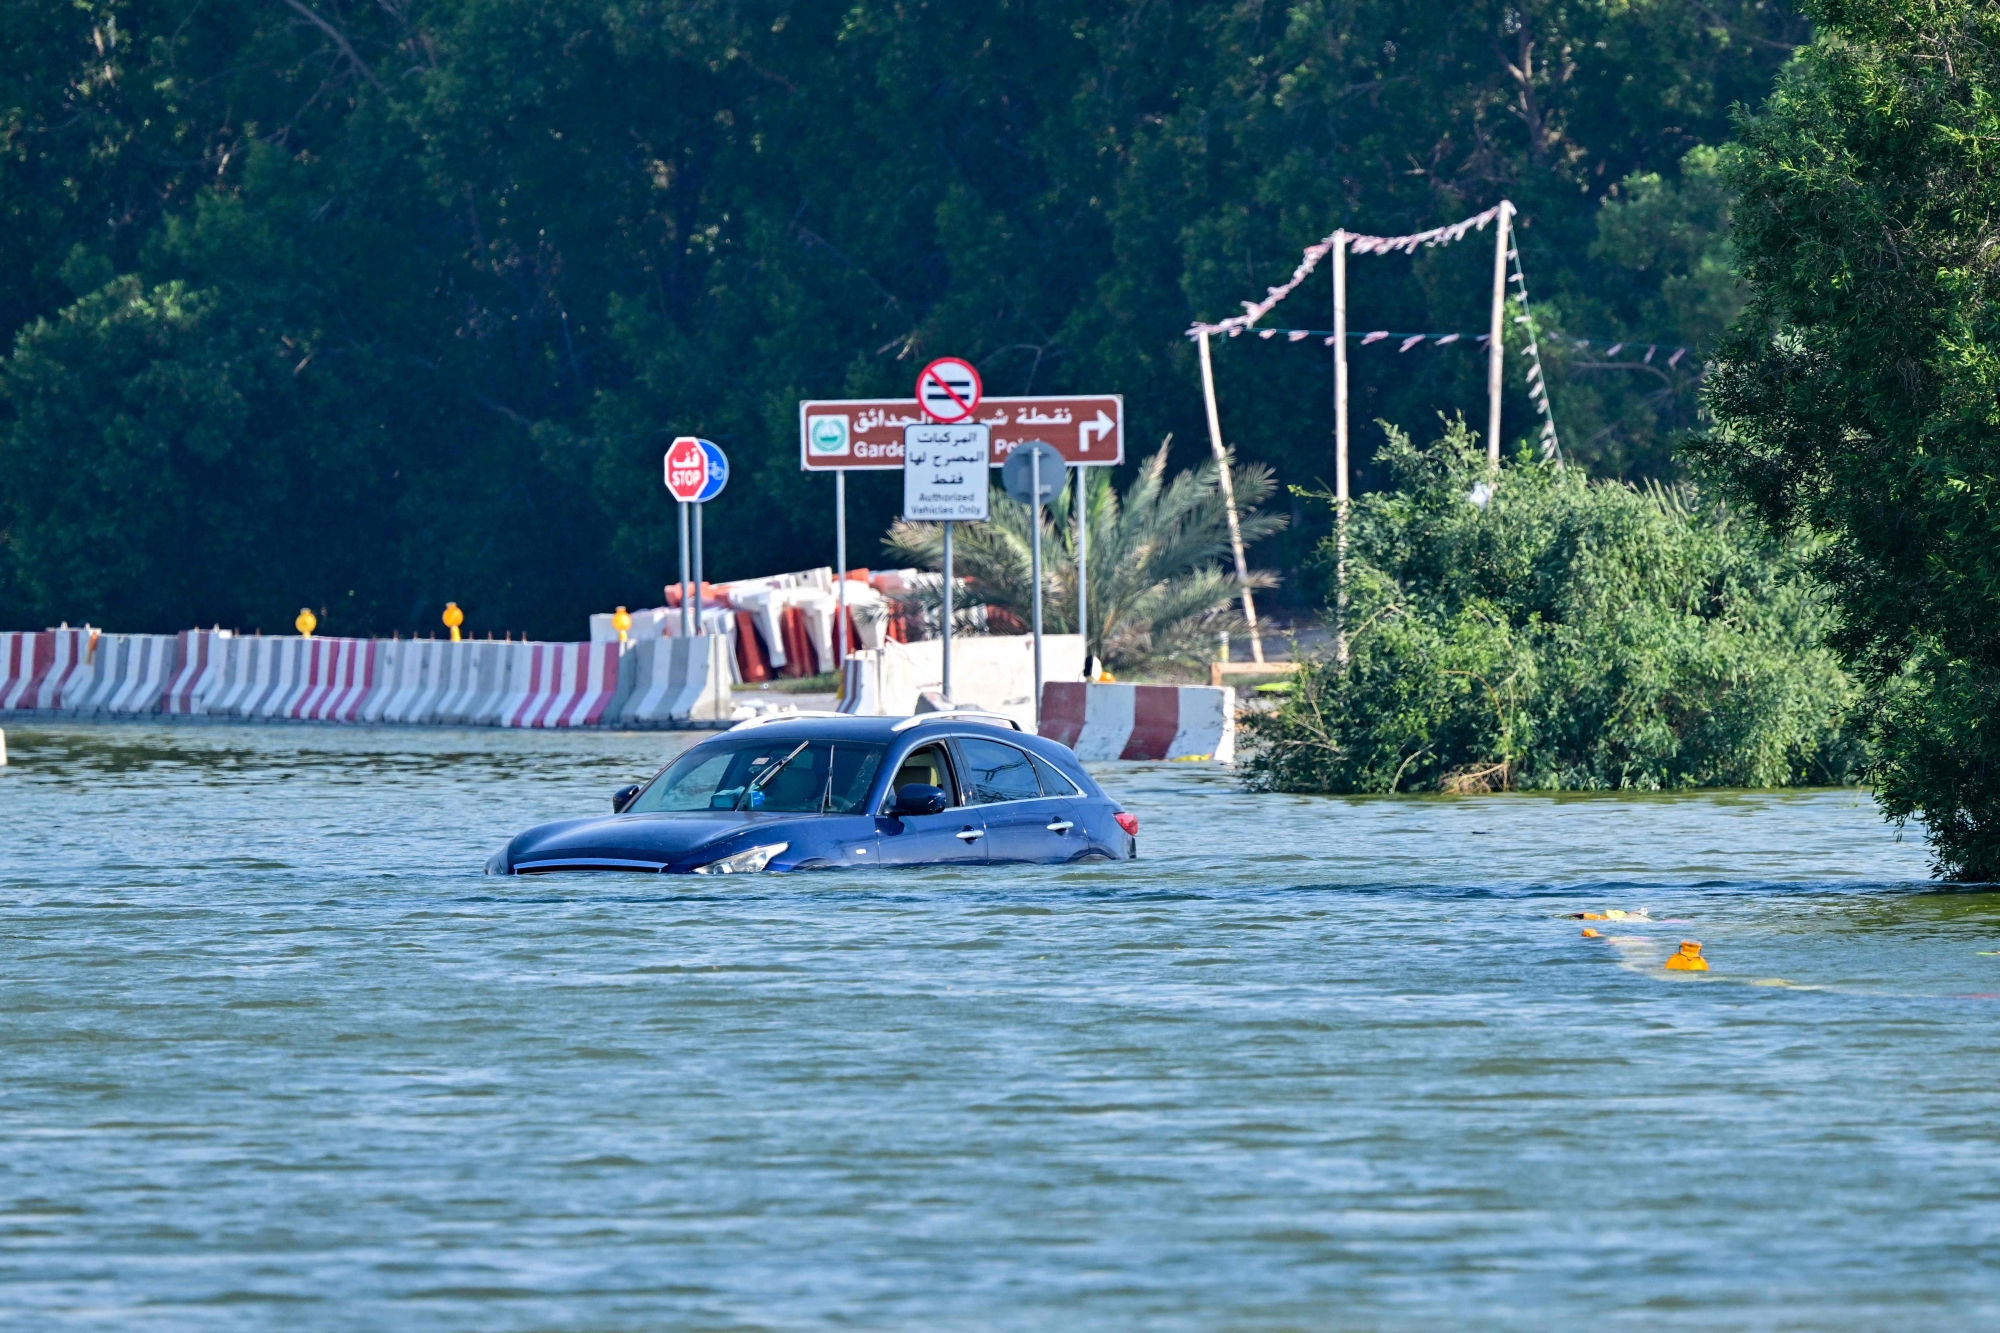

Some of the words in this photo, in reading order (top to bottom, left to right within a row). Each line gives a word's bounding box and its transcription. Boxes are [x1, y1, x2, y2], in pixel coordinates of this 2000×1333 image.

[1015, 407, 1072, 425] نقطة
[917, 431, 977, 446] المركبات
[853, 441, 905, 458] Garde
[673, 447, 700, 468] قف
[909, 451, 926, 466] لها
[932, 451, 984, 467] المصرح
[672, 470, 702, 486] STOP
[931, 472, 964, 485] فقط
[918, 493, 975, 502] Authorized
[911, 505, 954, 514] Vehicles
[958, 506, 981, 516] Only
